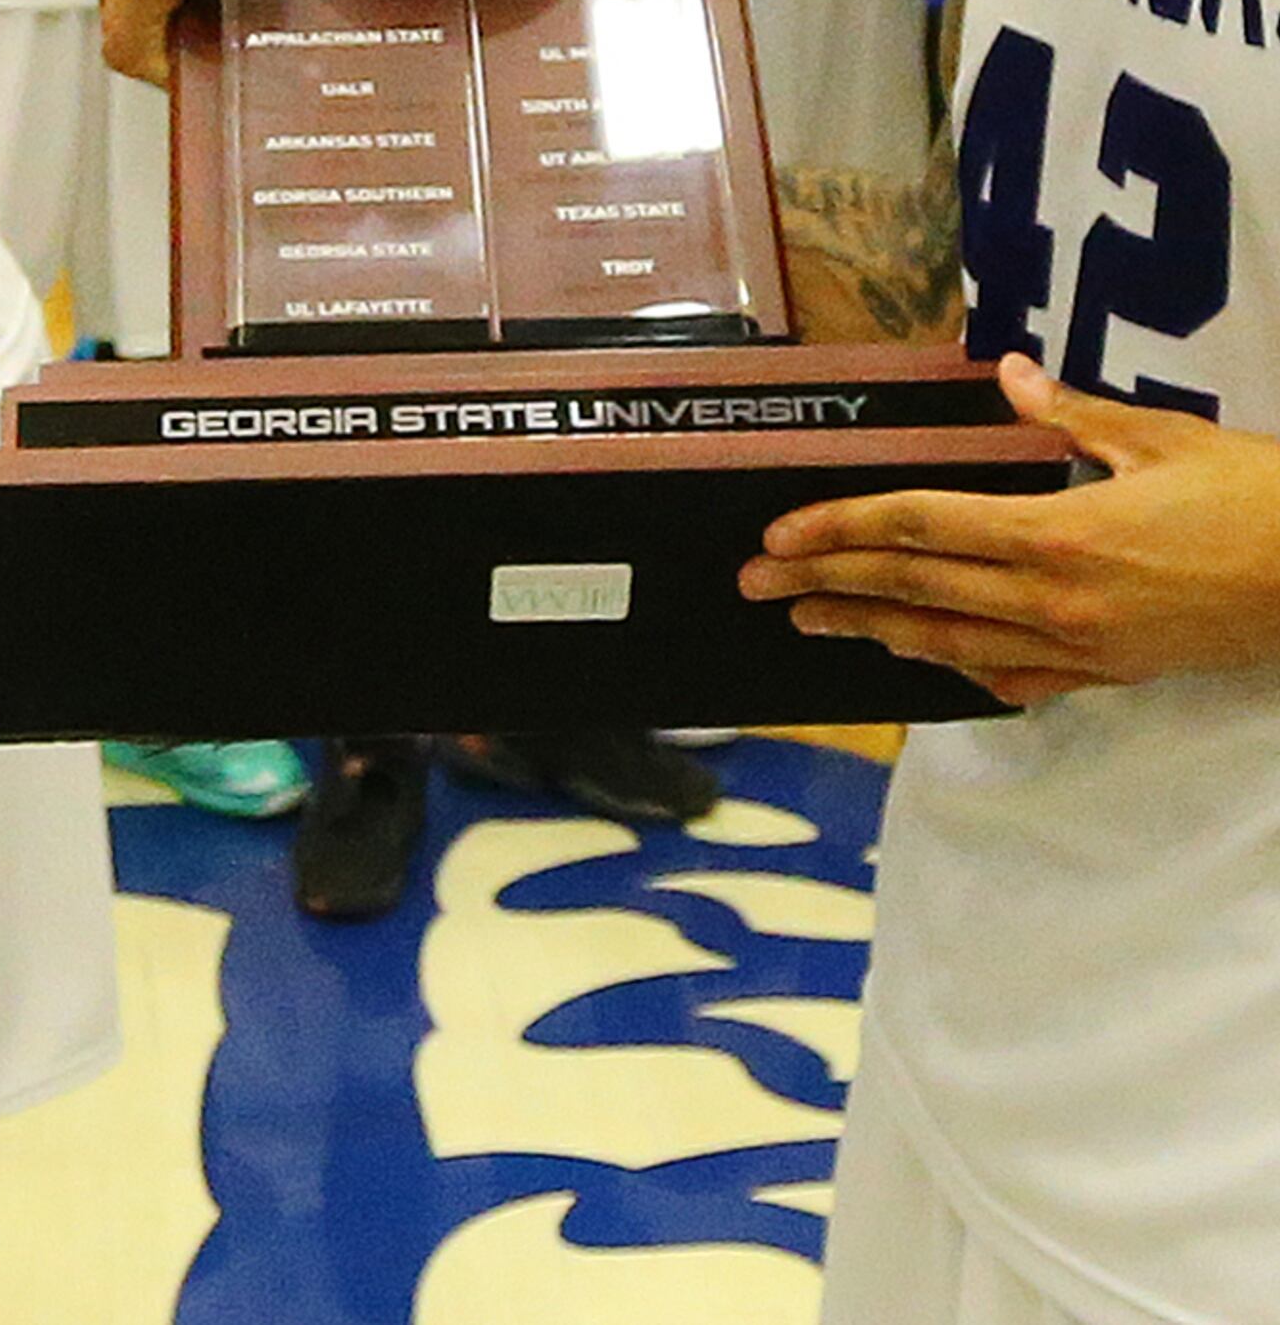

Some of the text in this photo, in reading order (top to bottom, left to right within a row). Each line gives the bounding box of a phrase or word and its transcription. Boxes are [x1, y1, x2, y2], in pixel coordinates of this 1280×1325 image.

[246, 28, 445, 48] APPALACHIAN STATE
[521, 98, 588, 114] SOUTH
[266, 132, 435, 151] ARKANSAS STATE
[539, 150, 567, 166] UT
[253, 186, 454, 205] GEORGIA SOUTHERN
[556, 201, 686, 221] TEXAS STATE
[957, 25, 1232, 423] 42
[279, 241, 434, 259] GEORGIA STATE
[600, 258, 655, 275] TROY
[285, 299, 434, 316] UL LAFAYETTE
[161, 394, 867, 438] GEORGIA STATE UNIVERSITY
